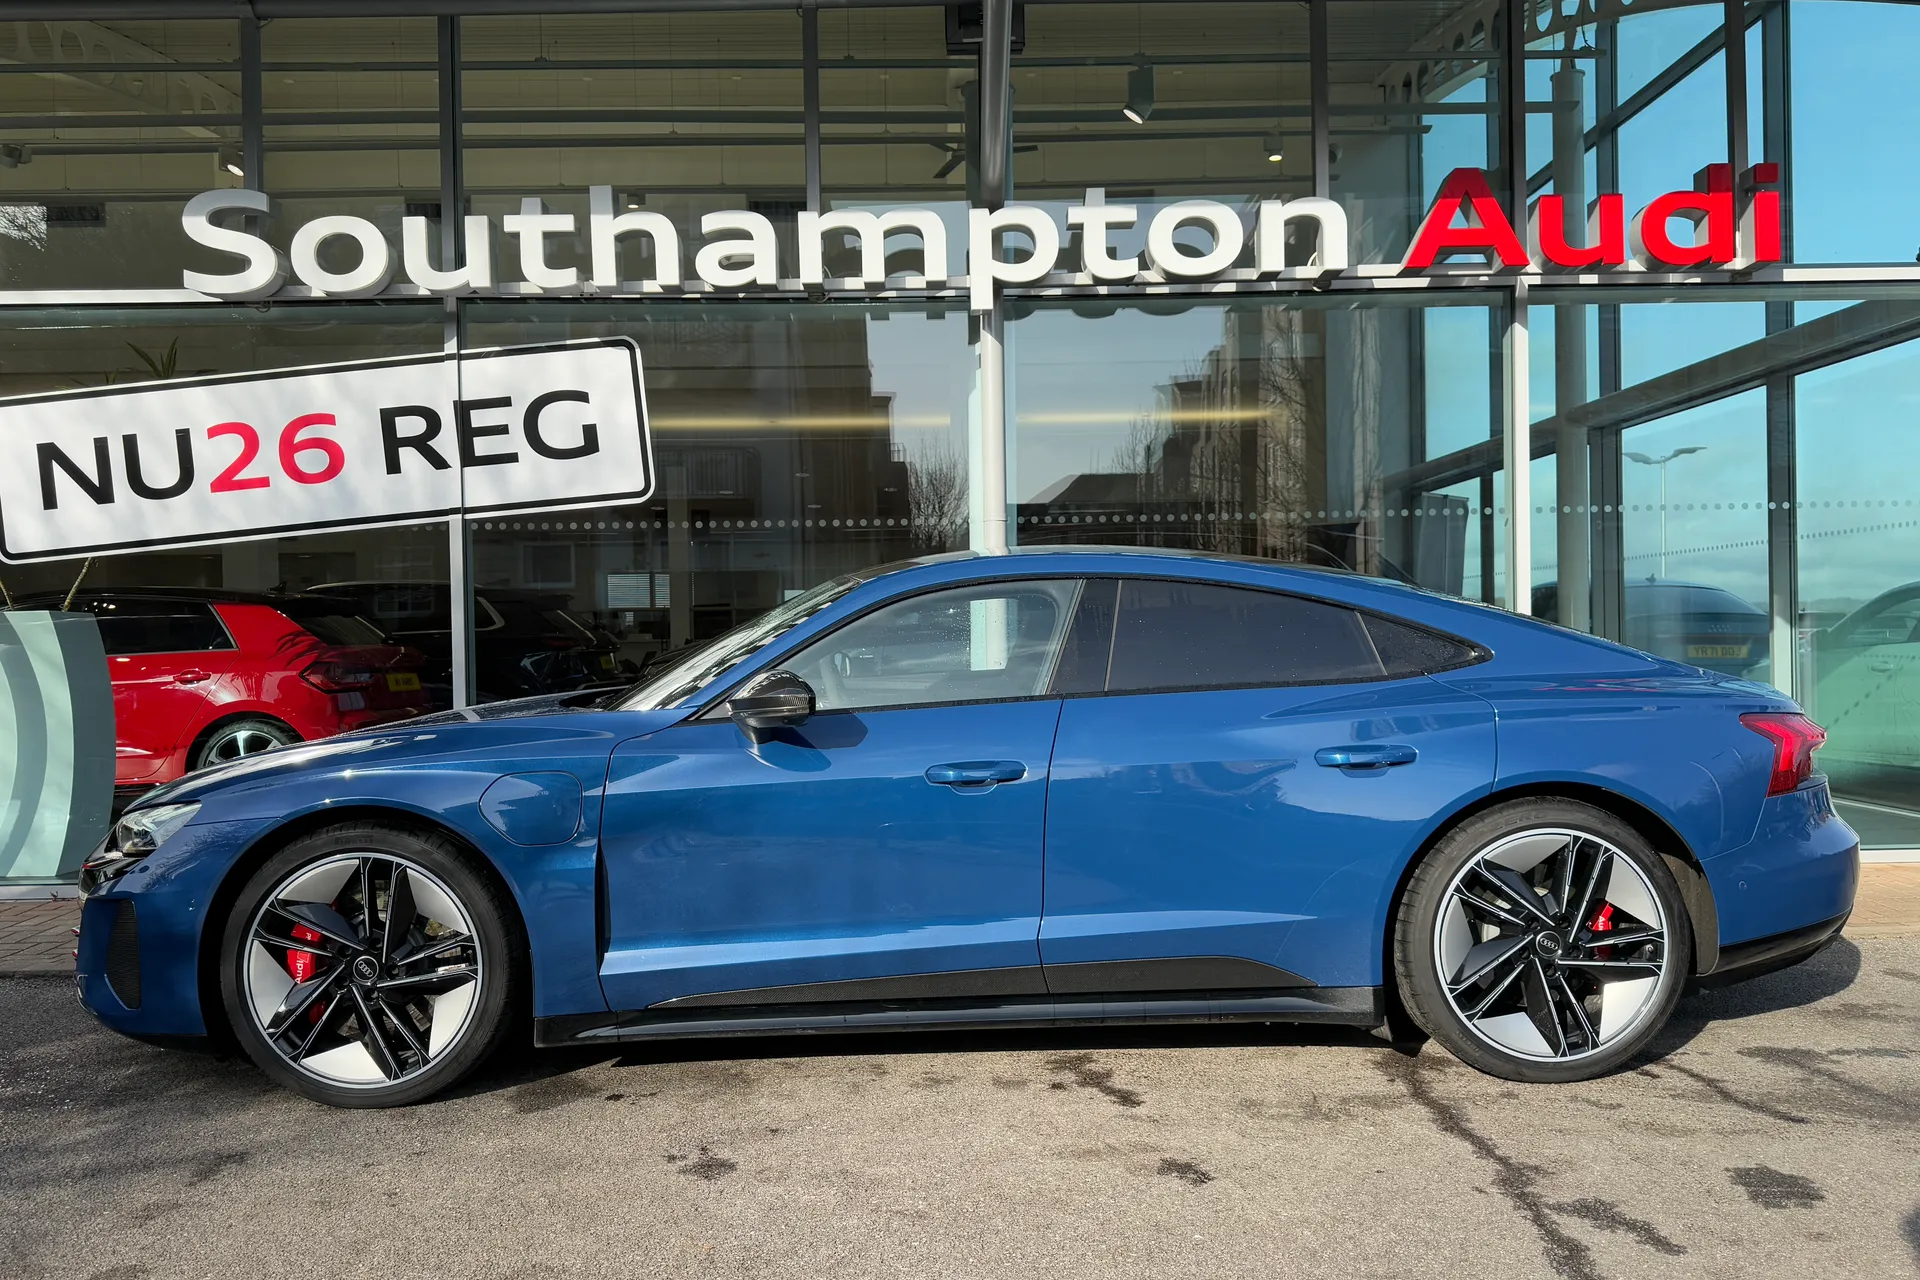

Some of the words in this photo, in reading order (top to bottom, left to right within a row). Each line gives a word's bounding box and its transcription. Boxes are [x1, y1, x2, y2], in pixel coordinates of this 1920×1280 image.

[181, 186, 1349, 311] Southampton
[1404, 162, 1781, 268] Audi
[36, 413, 346, 510] NU26
[380, 390, 600, 474] REG
[295, 960, 304, 984] Audi
